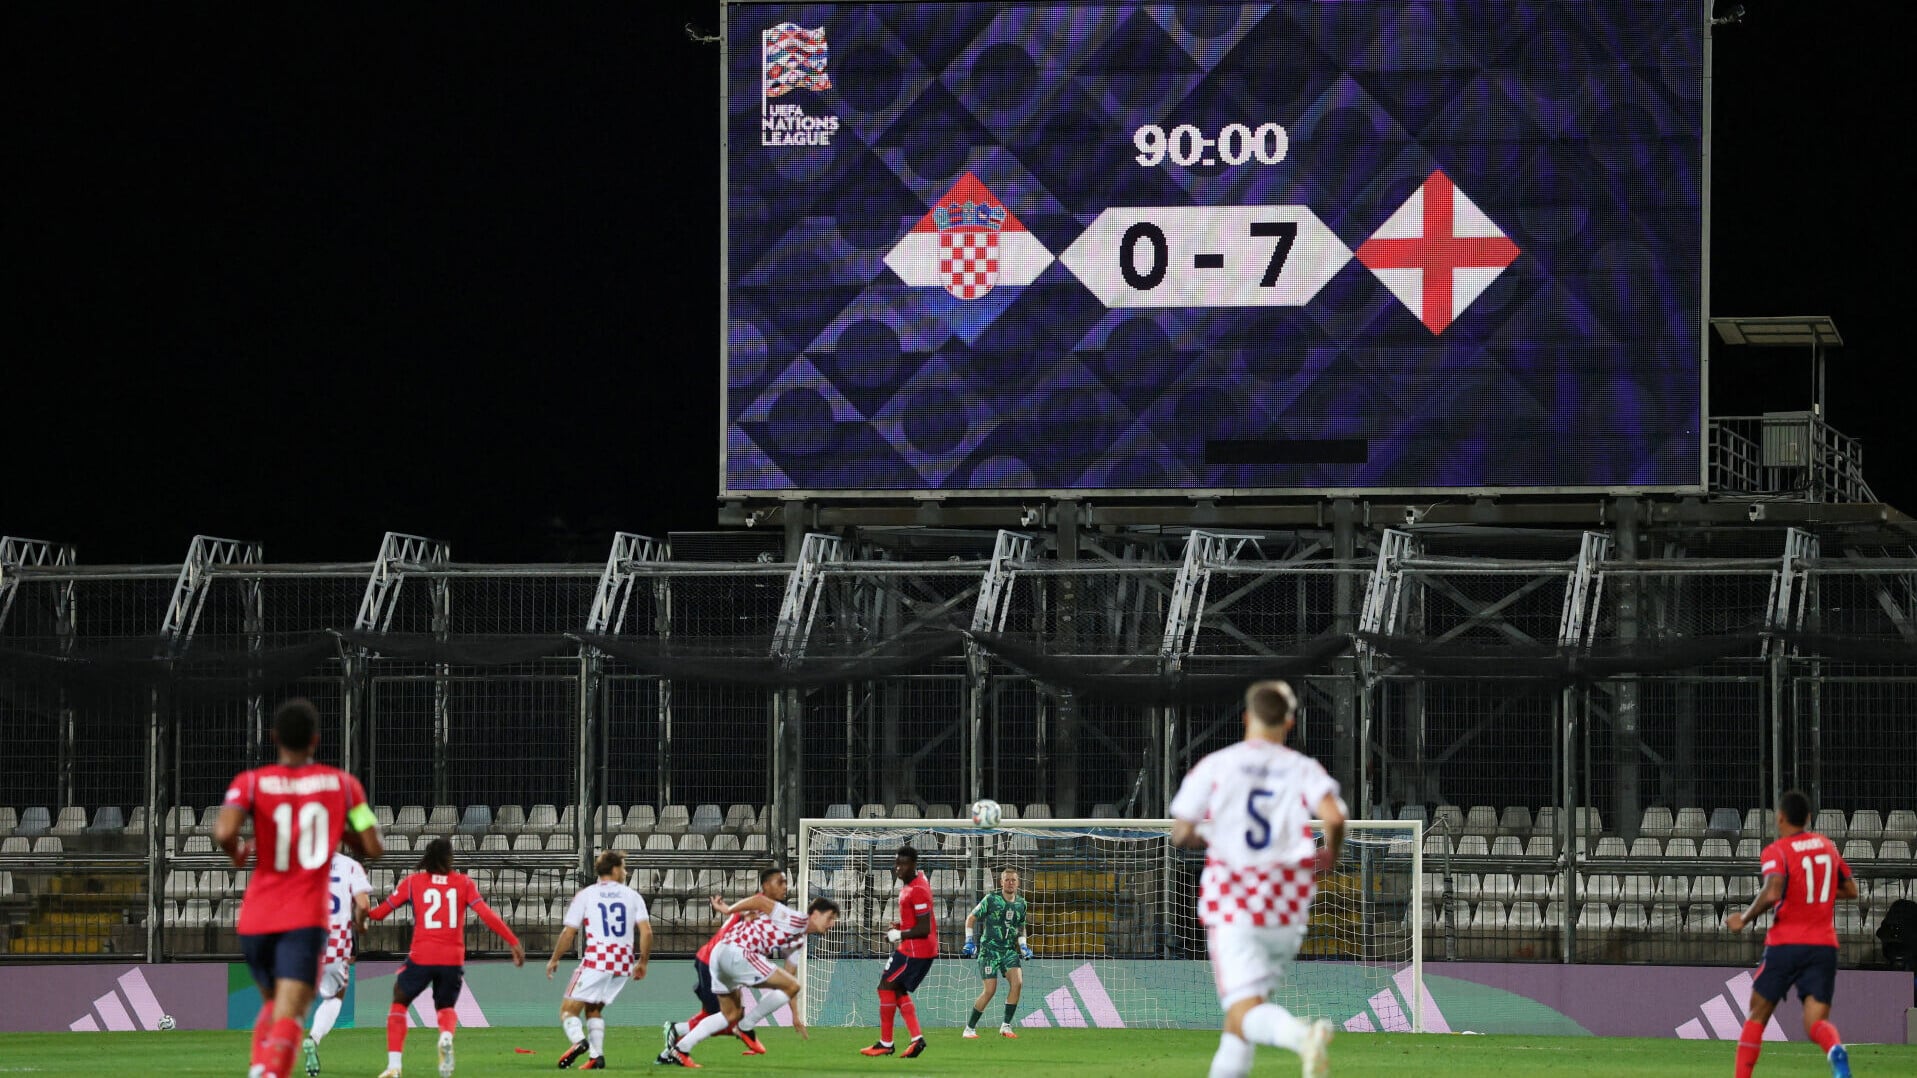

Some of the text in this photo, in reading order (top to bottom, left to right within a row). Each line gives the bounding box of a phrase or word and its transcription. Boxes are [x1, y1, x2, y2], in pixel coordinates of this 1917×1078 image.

[763, 115, 839, 131] NATIONS
[770, 104, 804, 117] UEFA
[763, 131, 831, 146] LEAGUE
[1133, 122, 1289, 167] 90:00
[1119, 222, 1168, 290] 0
[1250, 222, 1297, 287] 7
[273, 801, 329, 872] 10
[1245, 788, 1273, 850] 5
[1801, 854, 1832, 904] 17
[423, 888, 457, 929] 21
[597, 902, 626, 937] 13
